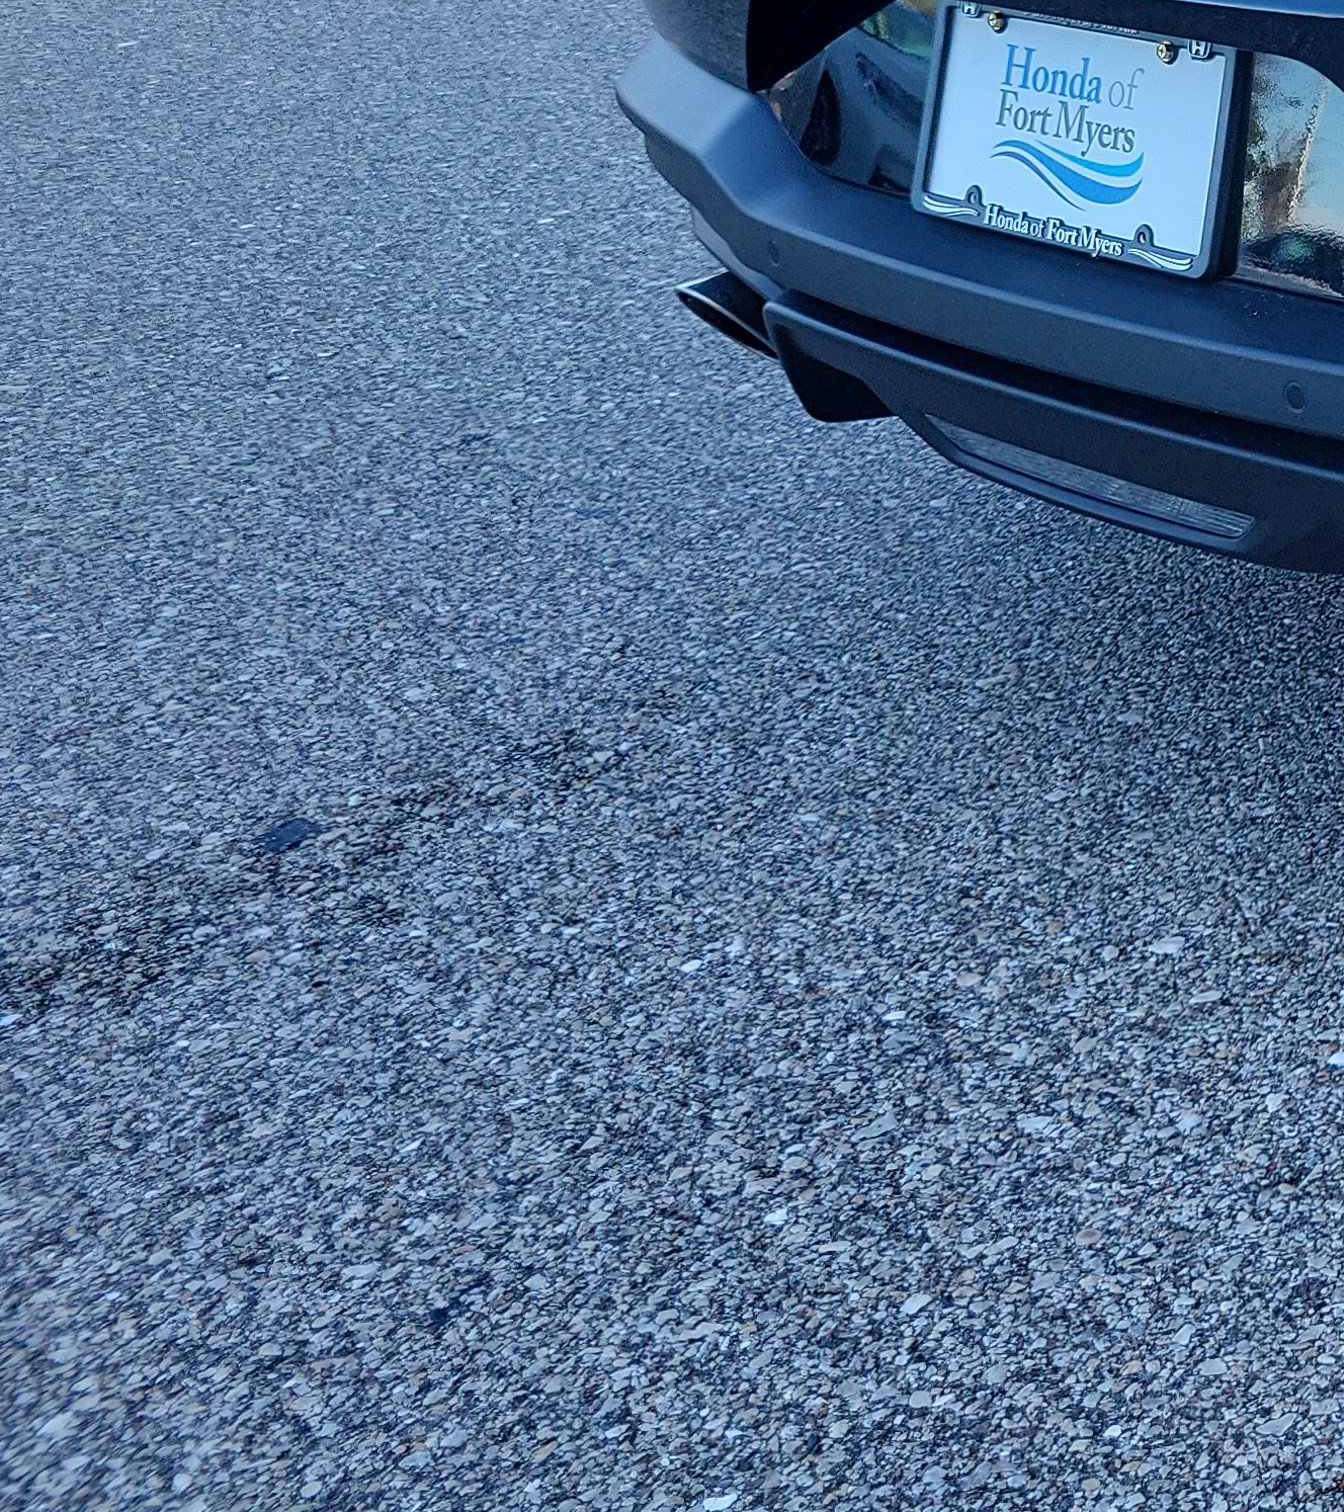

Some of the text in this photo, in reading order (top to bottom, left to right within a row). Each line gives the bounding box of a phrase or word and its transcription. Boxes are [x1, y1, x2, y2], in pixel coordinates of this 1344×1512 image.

[1001, 43, 1146, 110] Honda of
[995, 88, 1136, 157] Fort Myers
[983, 203, 1123, 258] Honda of Fort Myers
